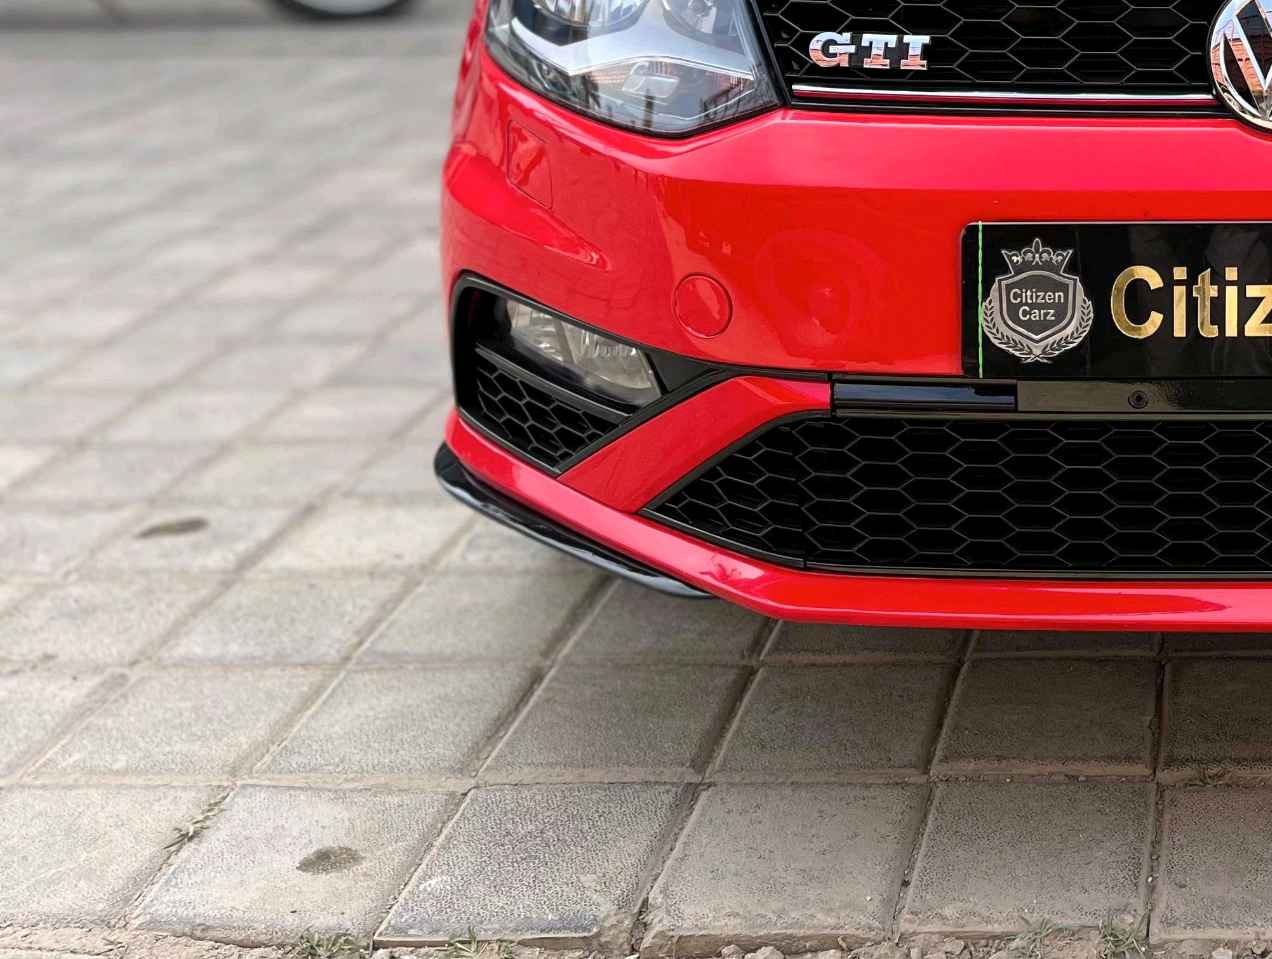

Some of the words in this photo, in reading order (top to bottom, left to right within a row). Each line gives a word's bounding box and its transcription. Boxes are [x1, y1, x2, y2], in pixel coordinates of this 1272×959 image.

[808, 31, 931, 70] GTI
[1009, 288, 1064, 304] Citizen
[1018, 305, 1056, 321] Carz
